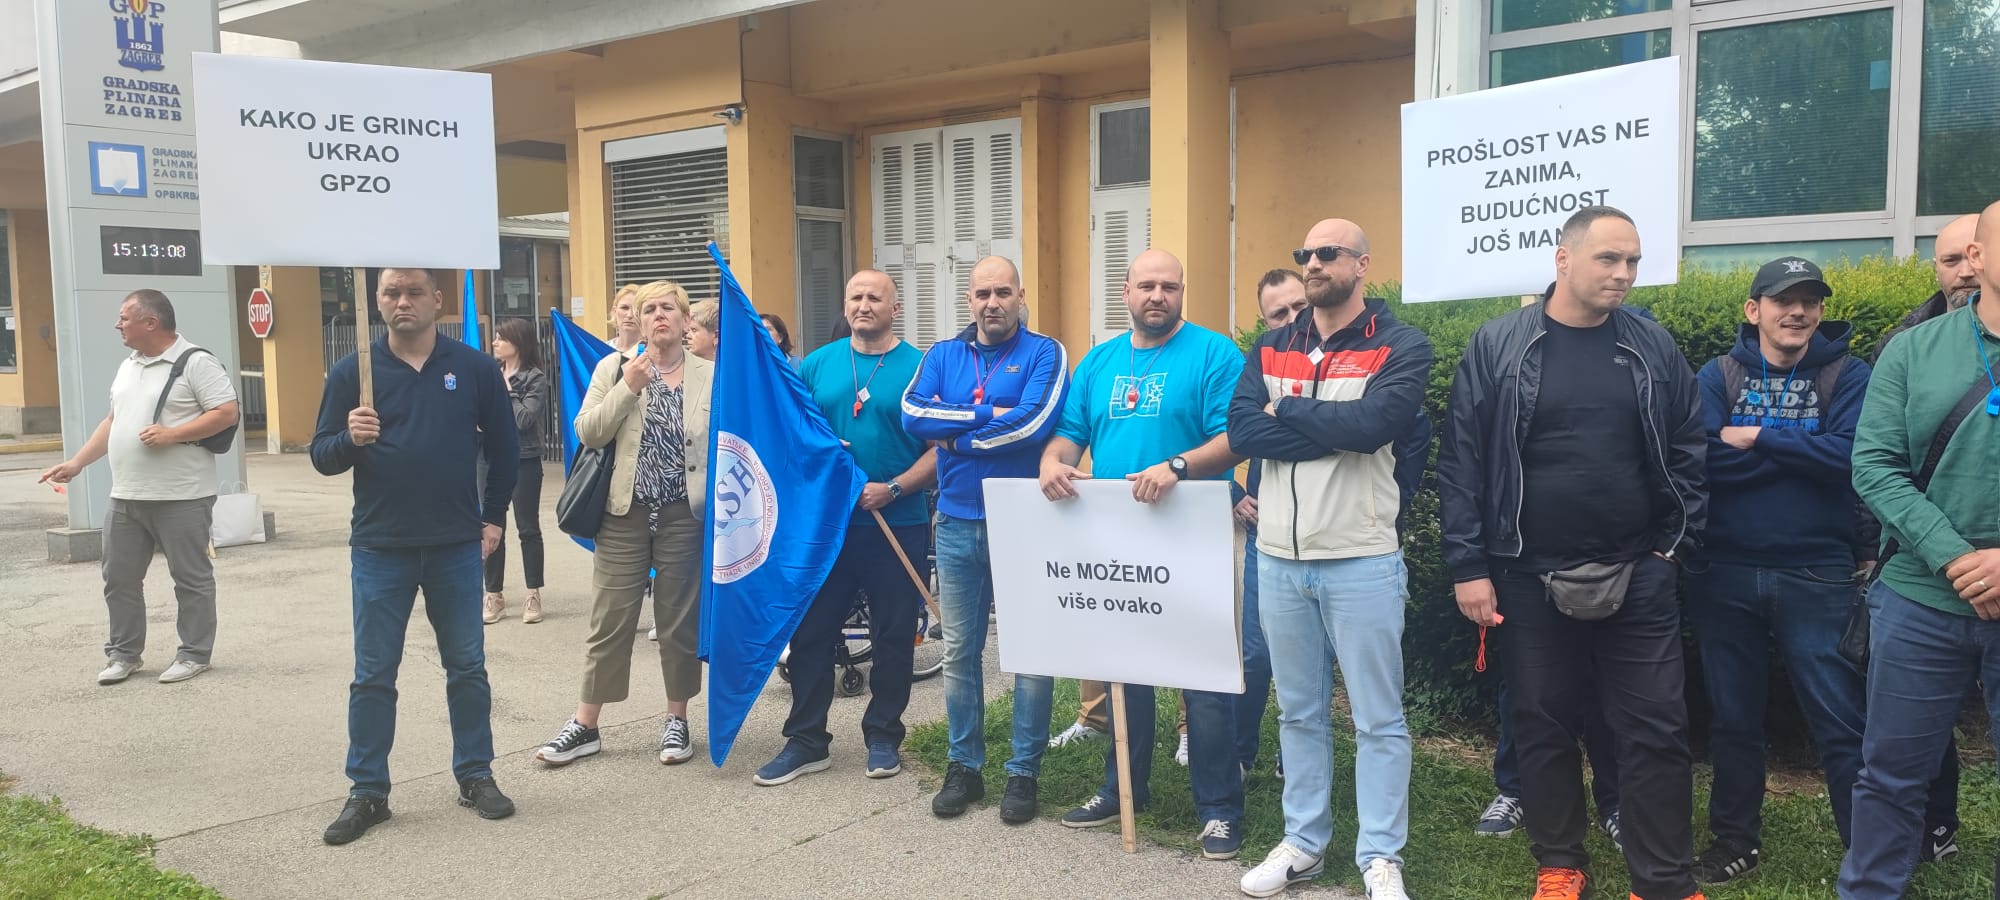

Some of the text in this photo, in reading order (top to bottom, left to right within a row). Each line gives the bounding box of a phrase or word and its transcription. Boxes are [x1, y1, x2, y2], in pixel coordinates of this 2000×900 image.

[120, 49, 163, 65] ZAGREB
[130, 42, 153, 51] 1862
[103, 76, 182, 96] GRADSKA
[104, 89, 182, 109] PLINARA
[105, 103, 182, 122] ZAGREB
[240, 108, 459, 138] KAKO JE GRINCH
[308, 142, 400, 163] UKRAO
[1427, 118, 1650, 168] PROŠLOST VAS NE
[320, 173, 391, 194] GPZO
[1484, 160, 1581, 189] ZANIMA,
[1461, 189, 1610, 224] BUDUĆNOST
[1467, 228, 1511, 255] JOŠ
[250, 303, 270, 323] STOP
[1046, 559, 1170, 584] Ne MOŽEMO
[1058, 592, 1163, 615] više ovako
